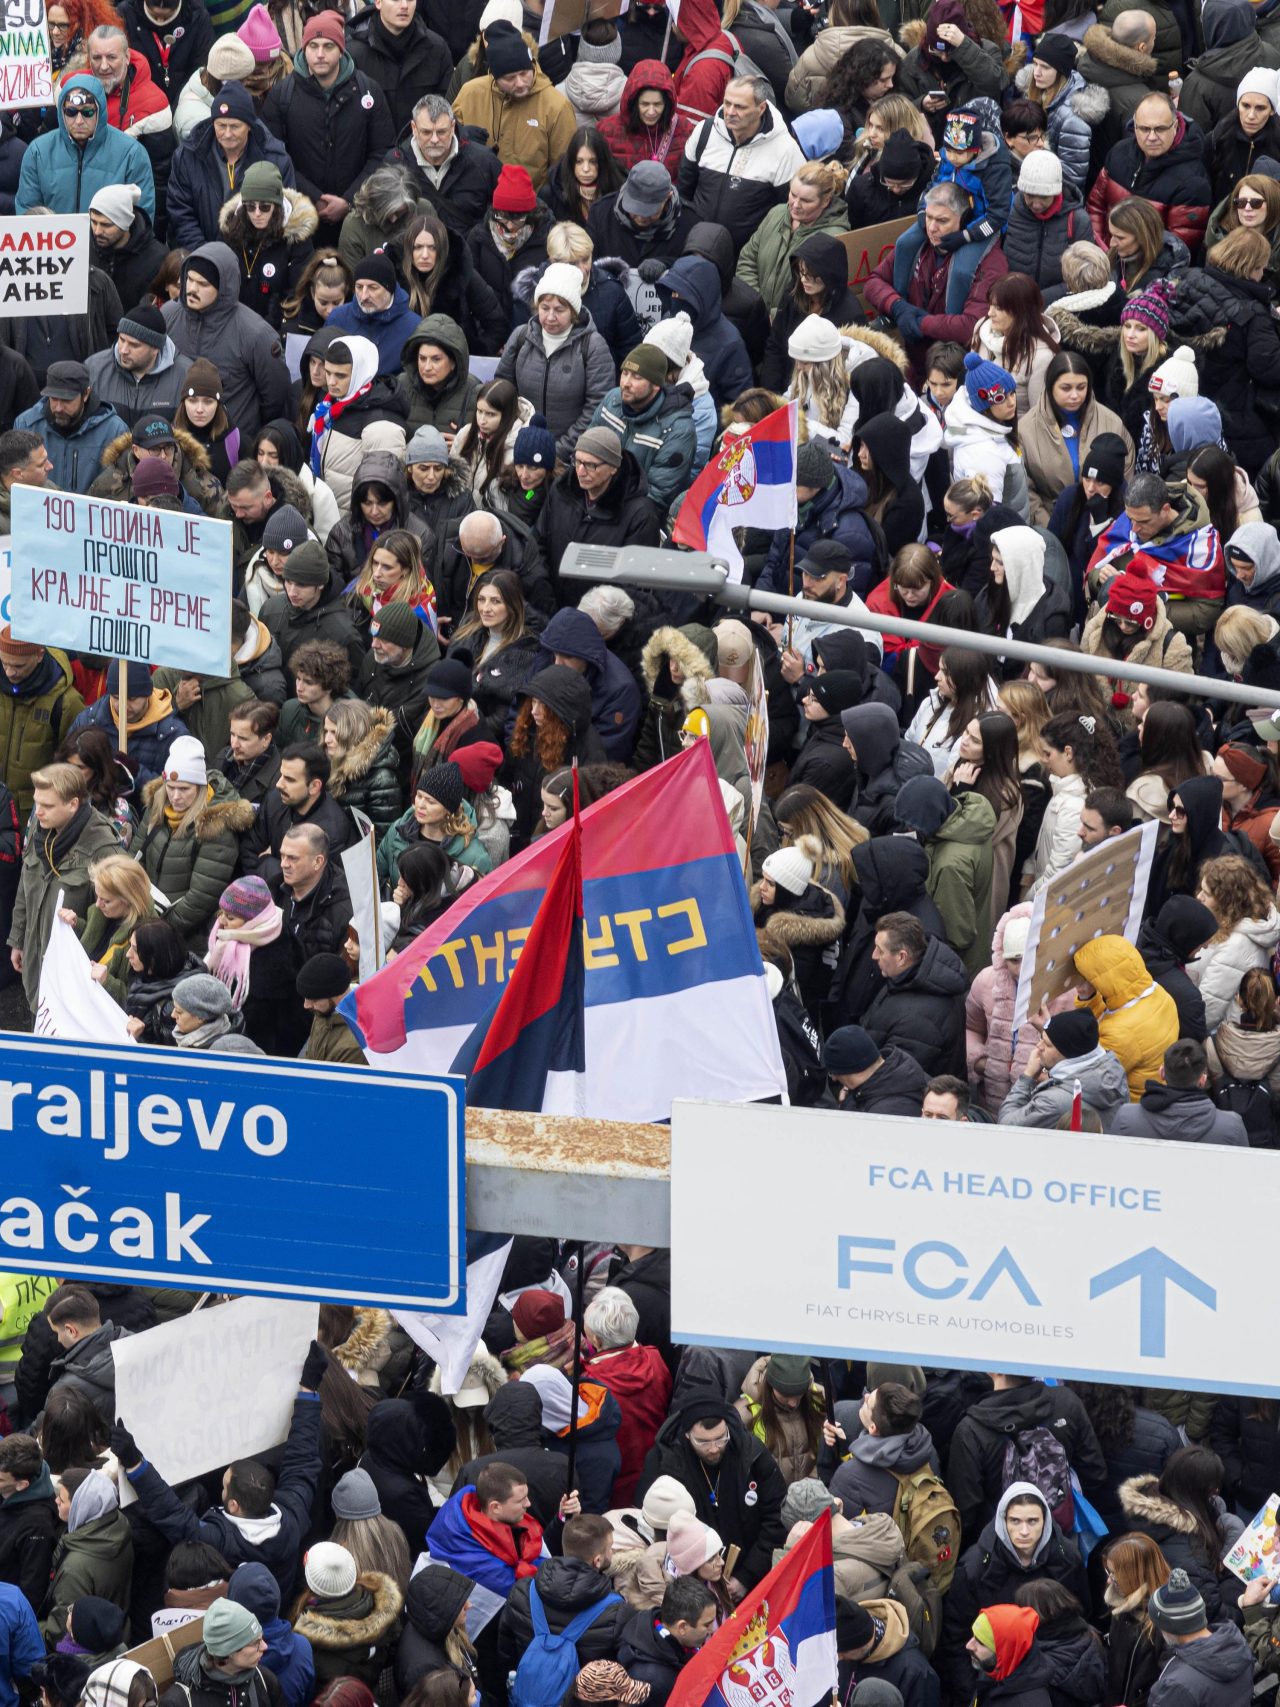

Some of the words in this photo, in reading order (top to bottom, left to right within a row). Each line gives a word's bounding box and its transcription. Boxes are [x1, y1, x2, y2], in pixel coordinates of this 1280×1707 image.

[43, 496, 75, 533] 190
[88, 504, 163, 548] ГОДИНА
[178, 521, 200, 556] ЈЕ
[84, 539, 158, 584] ПРОШЛО
[31, 567, 111, 614] КРАЈЊЕ
[116, 582, 141, 619] ЈЕ
[150, 587, 210, 632] ВРЕМЕ
[89, 615, 151, 660] ДОШЛО
[868, 1164, 933, 1191] FCA
[943, 1171, 1033, 1200] HEAD
[1044, 1181, 1162, 1212] OFFICE
[837, 1234, 1043, 1307] FCA
[805, 1303, 842, 1318] FIAT
[848, 1306, 939, 1327] CHRYSLER
[947, 1317, 1075, 1339] AUTOMOBILES
